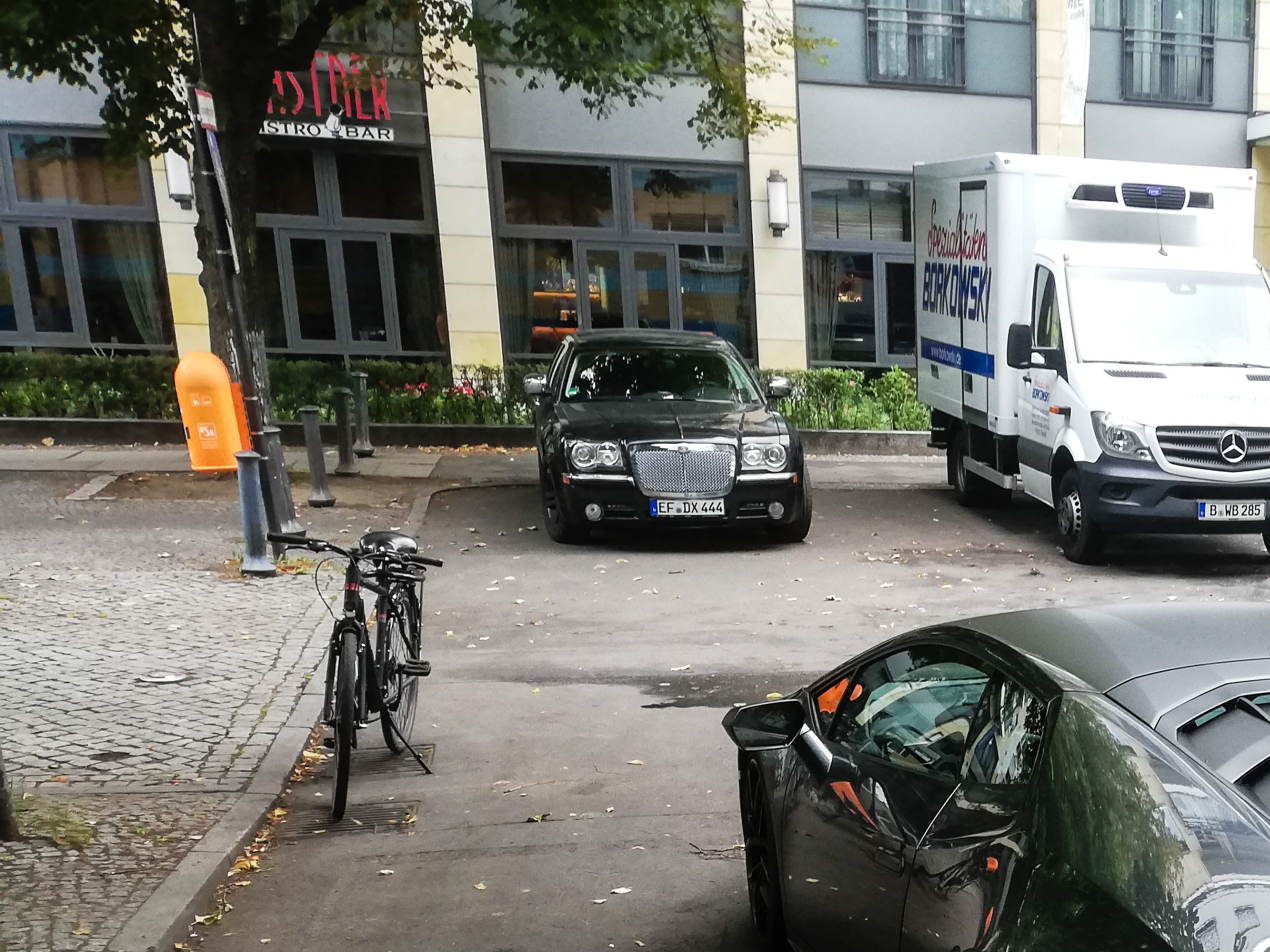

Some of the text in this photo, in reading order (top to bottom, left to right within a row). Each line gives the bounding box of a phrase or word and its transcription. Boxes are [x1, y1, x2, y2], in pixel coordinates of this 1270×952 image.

[346, 126, 391, 140] BAR
[922, 261, 992, 323] BORKOWSKI
[658, 501, 723, 513] EF DX 444
[1209, 504, 1261, 516] B WB 285
